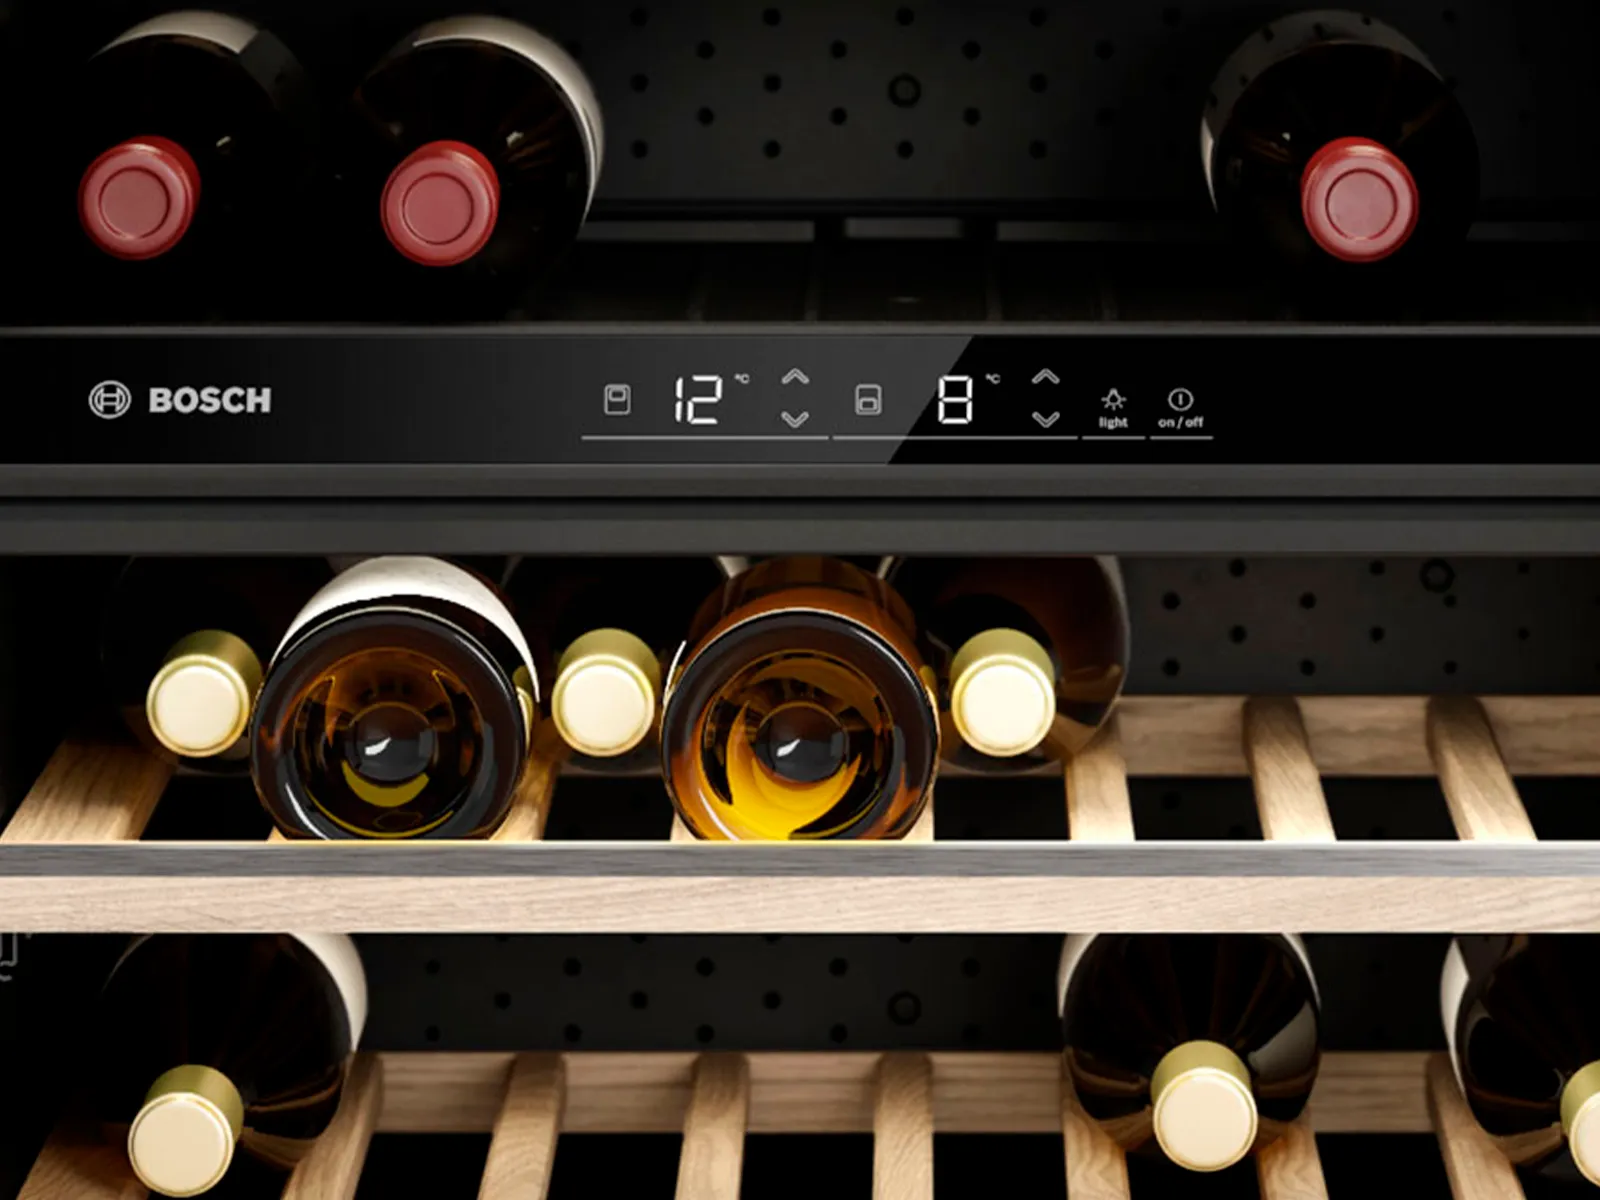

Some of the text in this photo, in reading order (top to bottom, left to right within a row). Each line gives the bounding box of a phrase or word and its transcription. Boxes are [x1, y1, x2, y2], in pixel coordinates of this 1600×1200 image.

[149, 386, 272, 414] BOSCH
[675, 375, 723, 424] 12
[938, 375, 973, 424] 8
[1099, 416, 1129, 430] light
